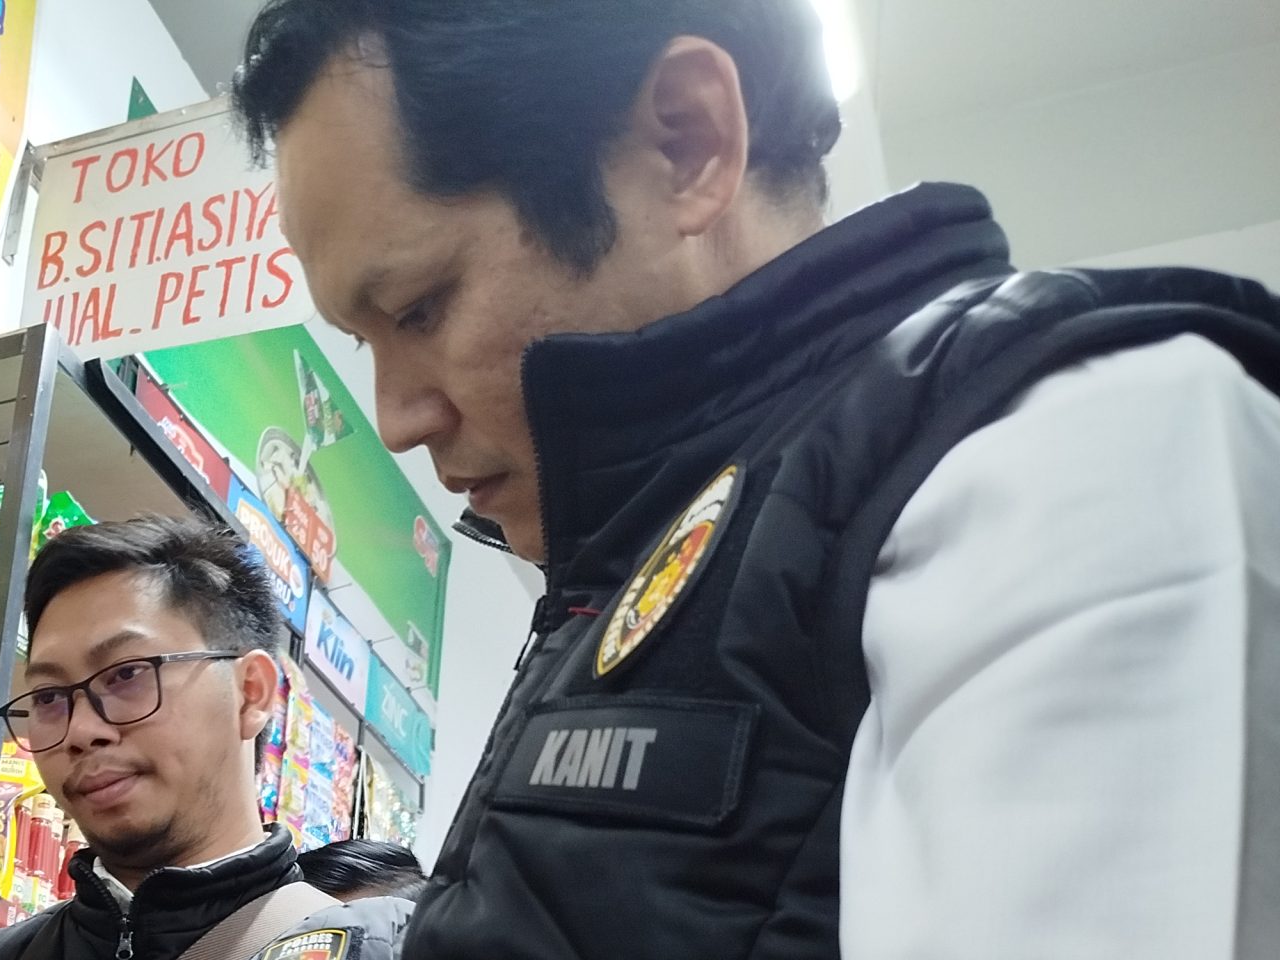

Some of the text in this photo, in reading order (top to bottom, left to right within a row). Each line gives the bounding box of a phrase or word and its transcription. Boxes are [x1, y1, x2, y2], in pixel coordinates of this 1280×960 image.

[71, 131, 206, 204] TOKO
[152, 246, 296, 331] PETIS
[315, 621, 355, 682] Klin
[529, 727, 658, 790] KANIT
